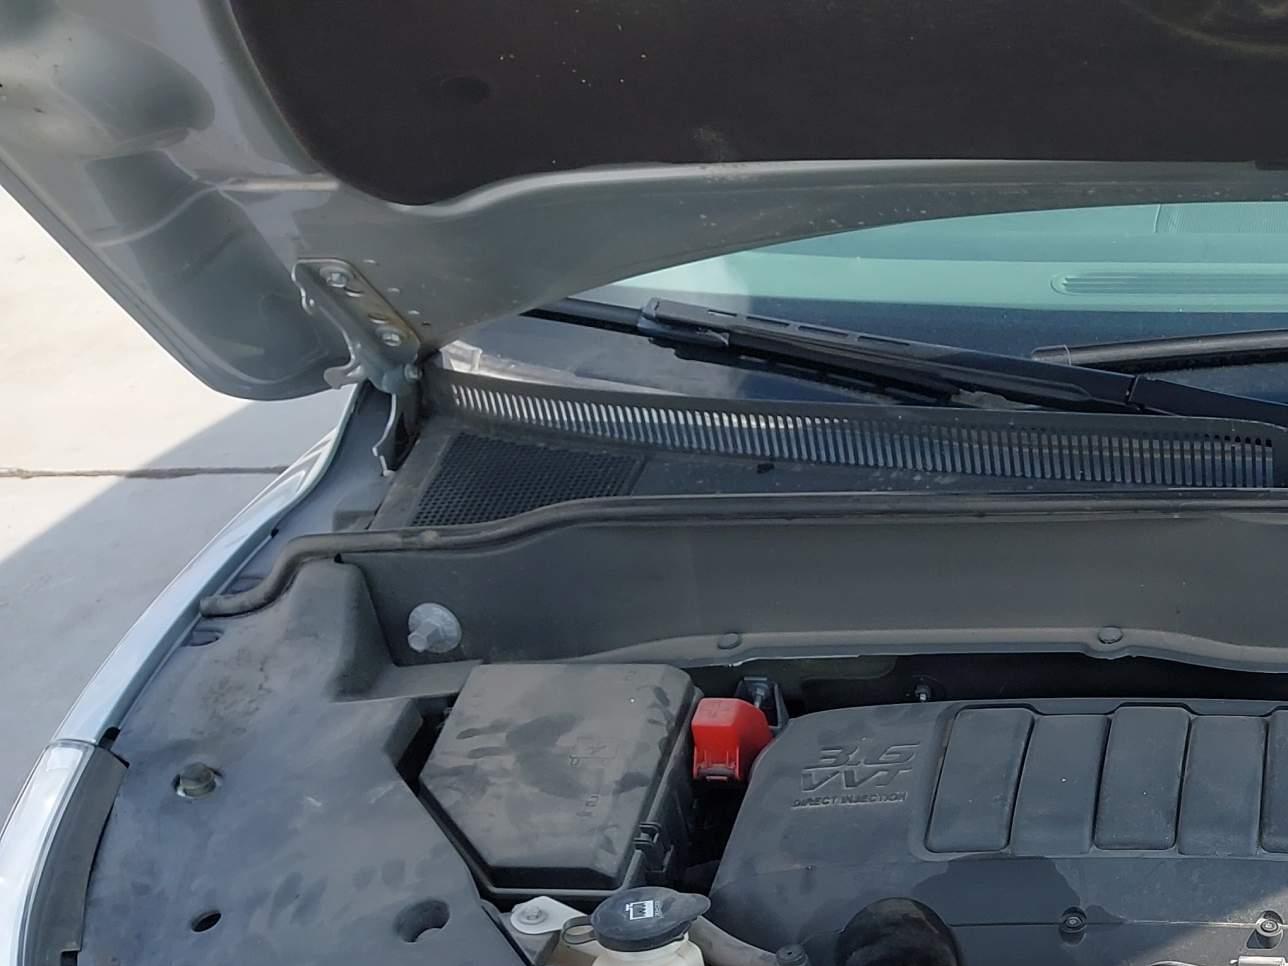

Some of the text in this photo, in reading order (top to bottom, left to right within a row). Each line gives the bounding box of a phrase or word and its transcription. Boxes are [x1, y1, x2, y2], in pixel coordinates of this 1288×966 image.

[802, 741, 921, 772] 3.6
[801, 766, 912, 793] VVT
[791, 791, 908, 810] DIRECT INJECTION
